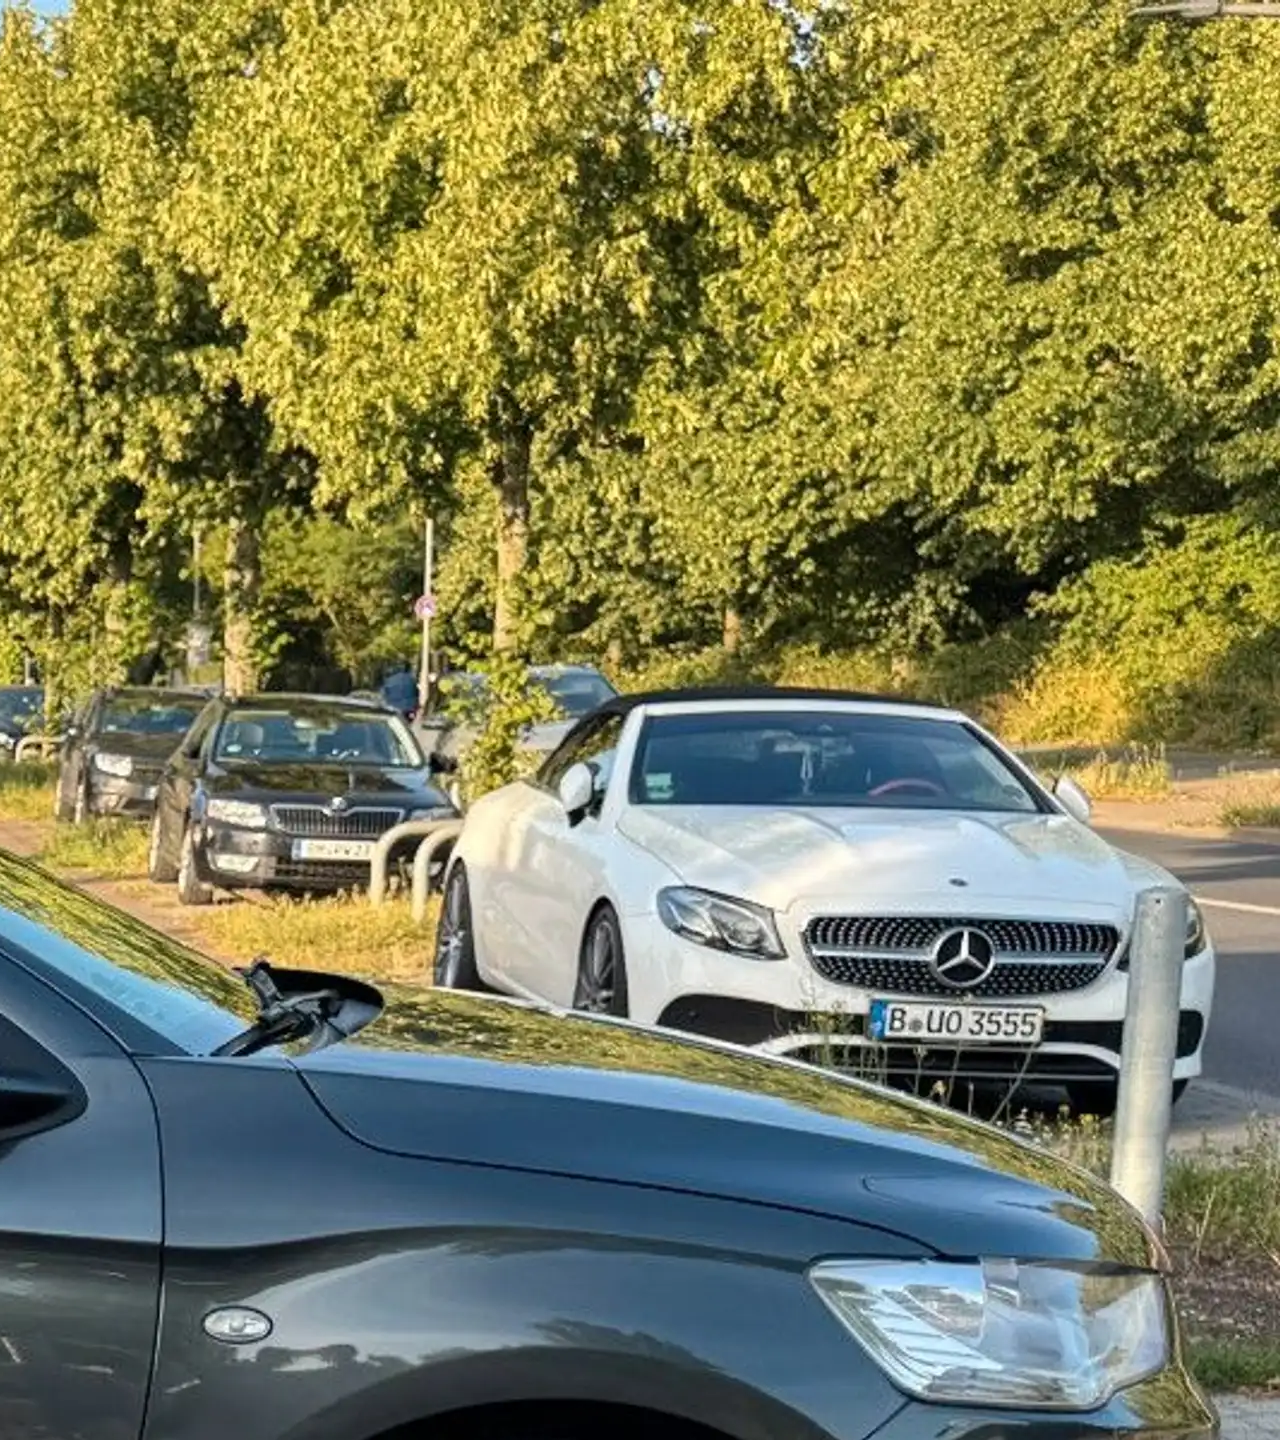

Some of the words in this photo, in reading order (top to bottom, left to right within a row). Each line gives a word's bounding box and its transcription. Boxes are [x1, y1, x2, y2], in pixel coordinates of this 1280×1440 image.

[890, 1007, 907, 1032] B
[927, 1009, 963, 1034] UO
[968, 1010, 1037, 1037] 3555
